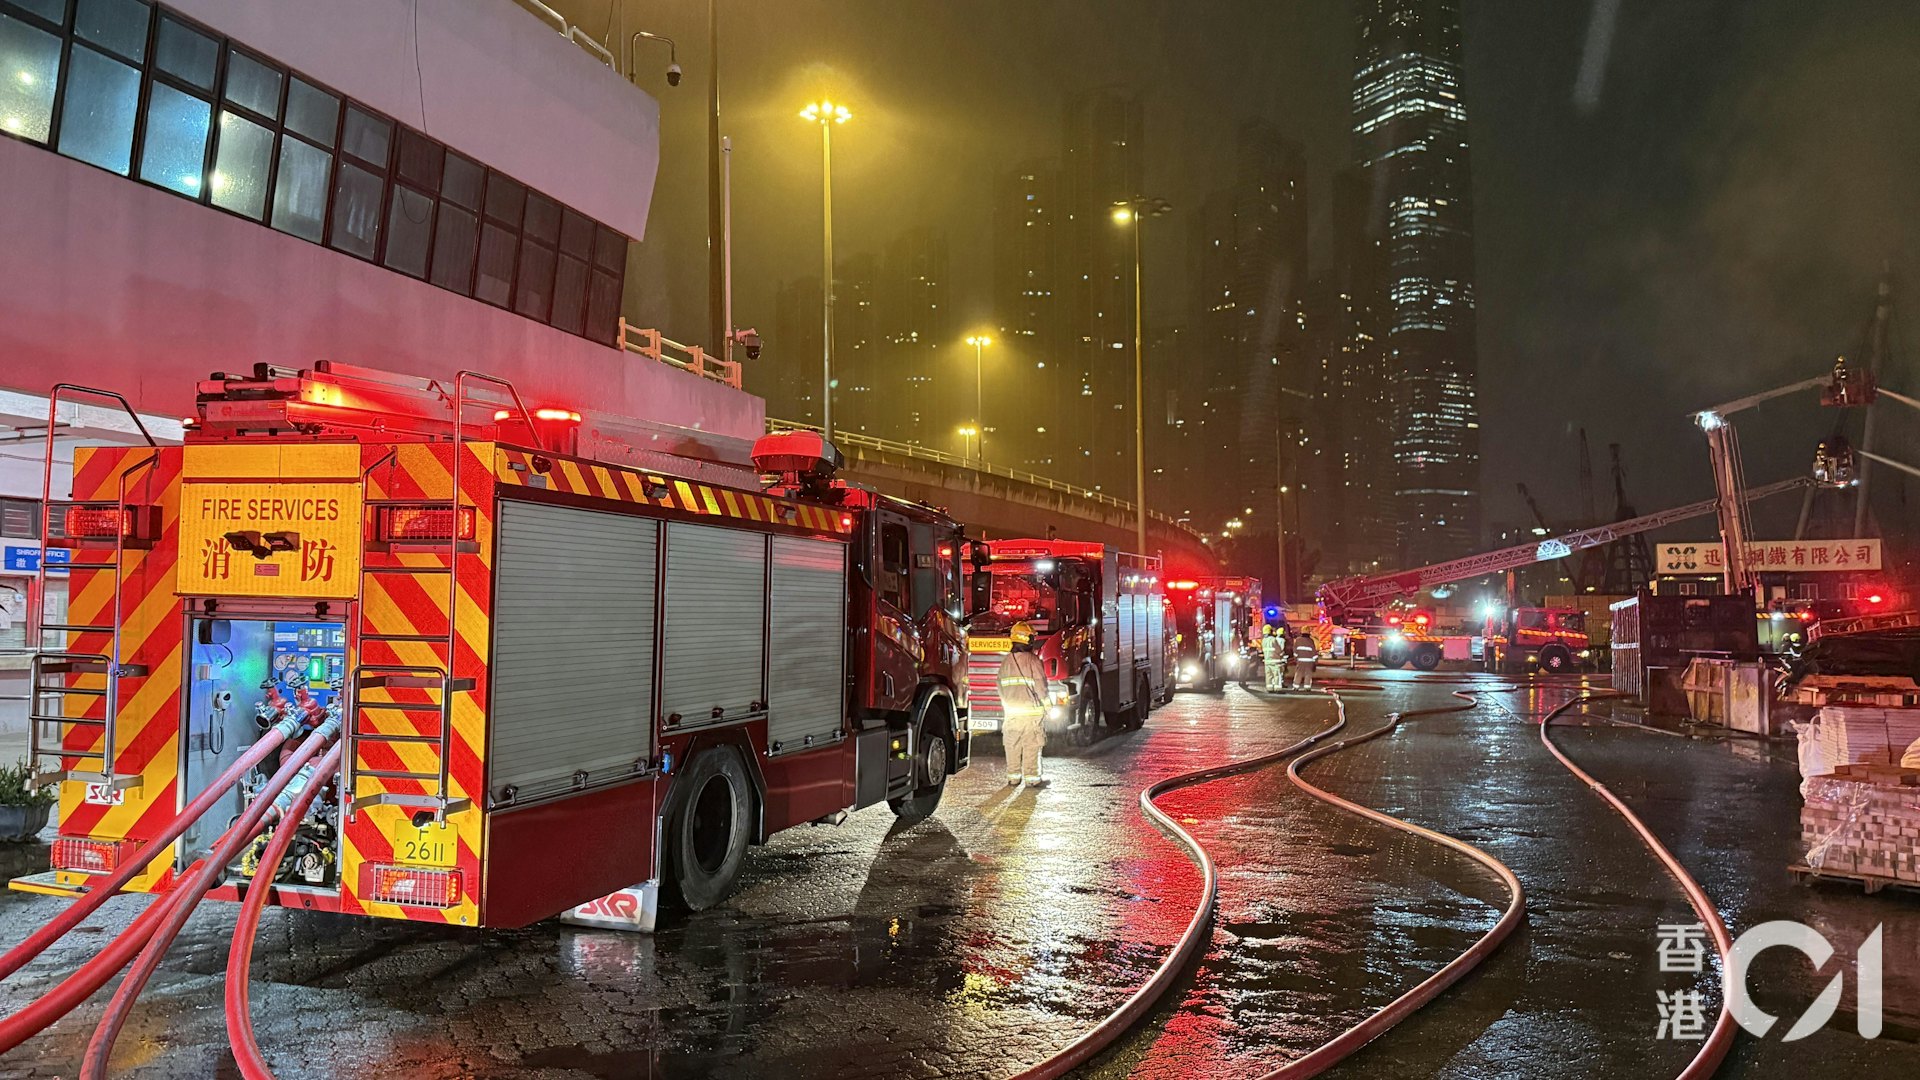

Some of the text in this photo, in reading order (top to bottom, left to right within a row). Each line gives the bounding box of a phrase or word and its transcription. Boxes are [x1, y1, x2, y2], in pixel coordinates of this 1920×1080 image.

[202, 499, 339, 520] FIRE SERVICES
[44, 550, 66, 558] FFICE
[1703, 545, 1872, 567] 迅鋼鐵有限公司
[970, 640, 1002, 648] SERVICES
[972, 720, 993, 728] 7509
[405, 841, 444, 862] 2611
